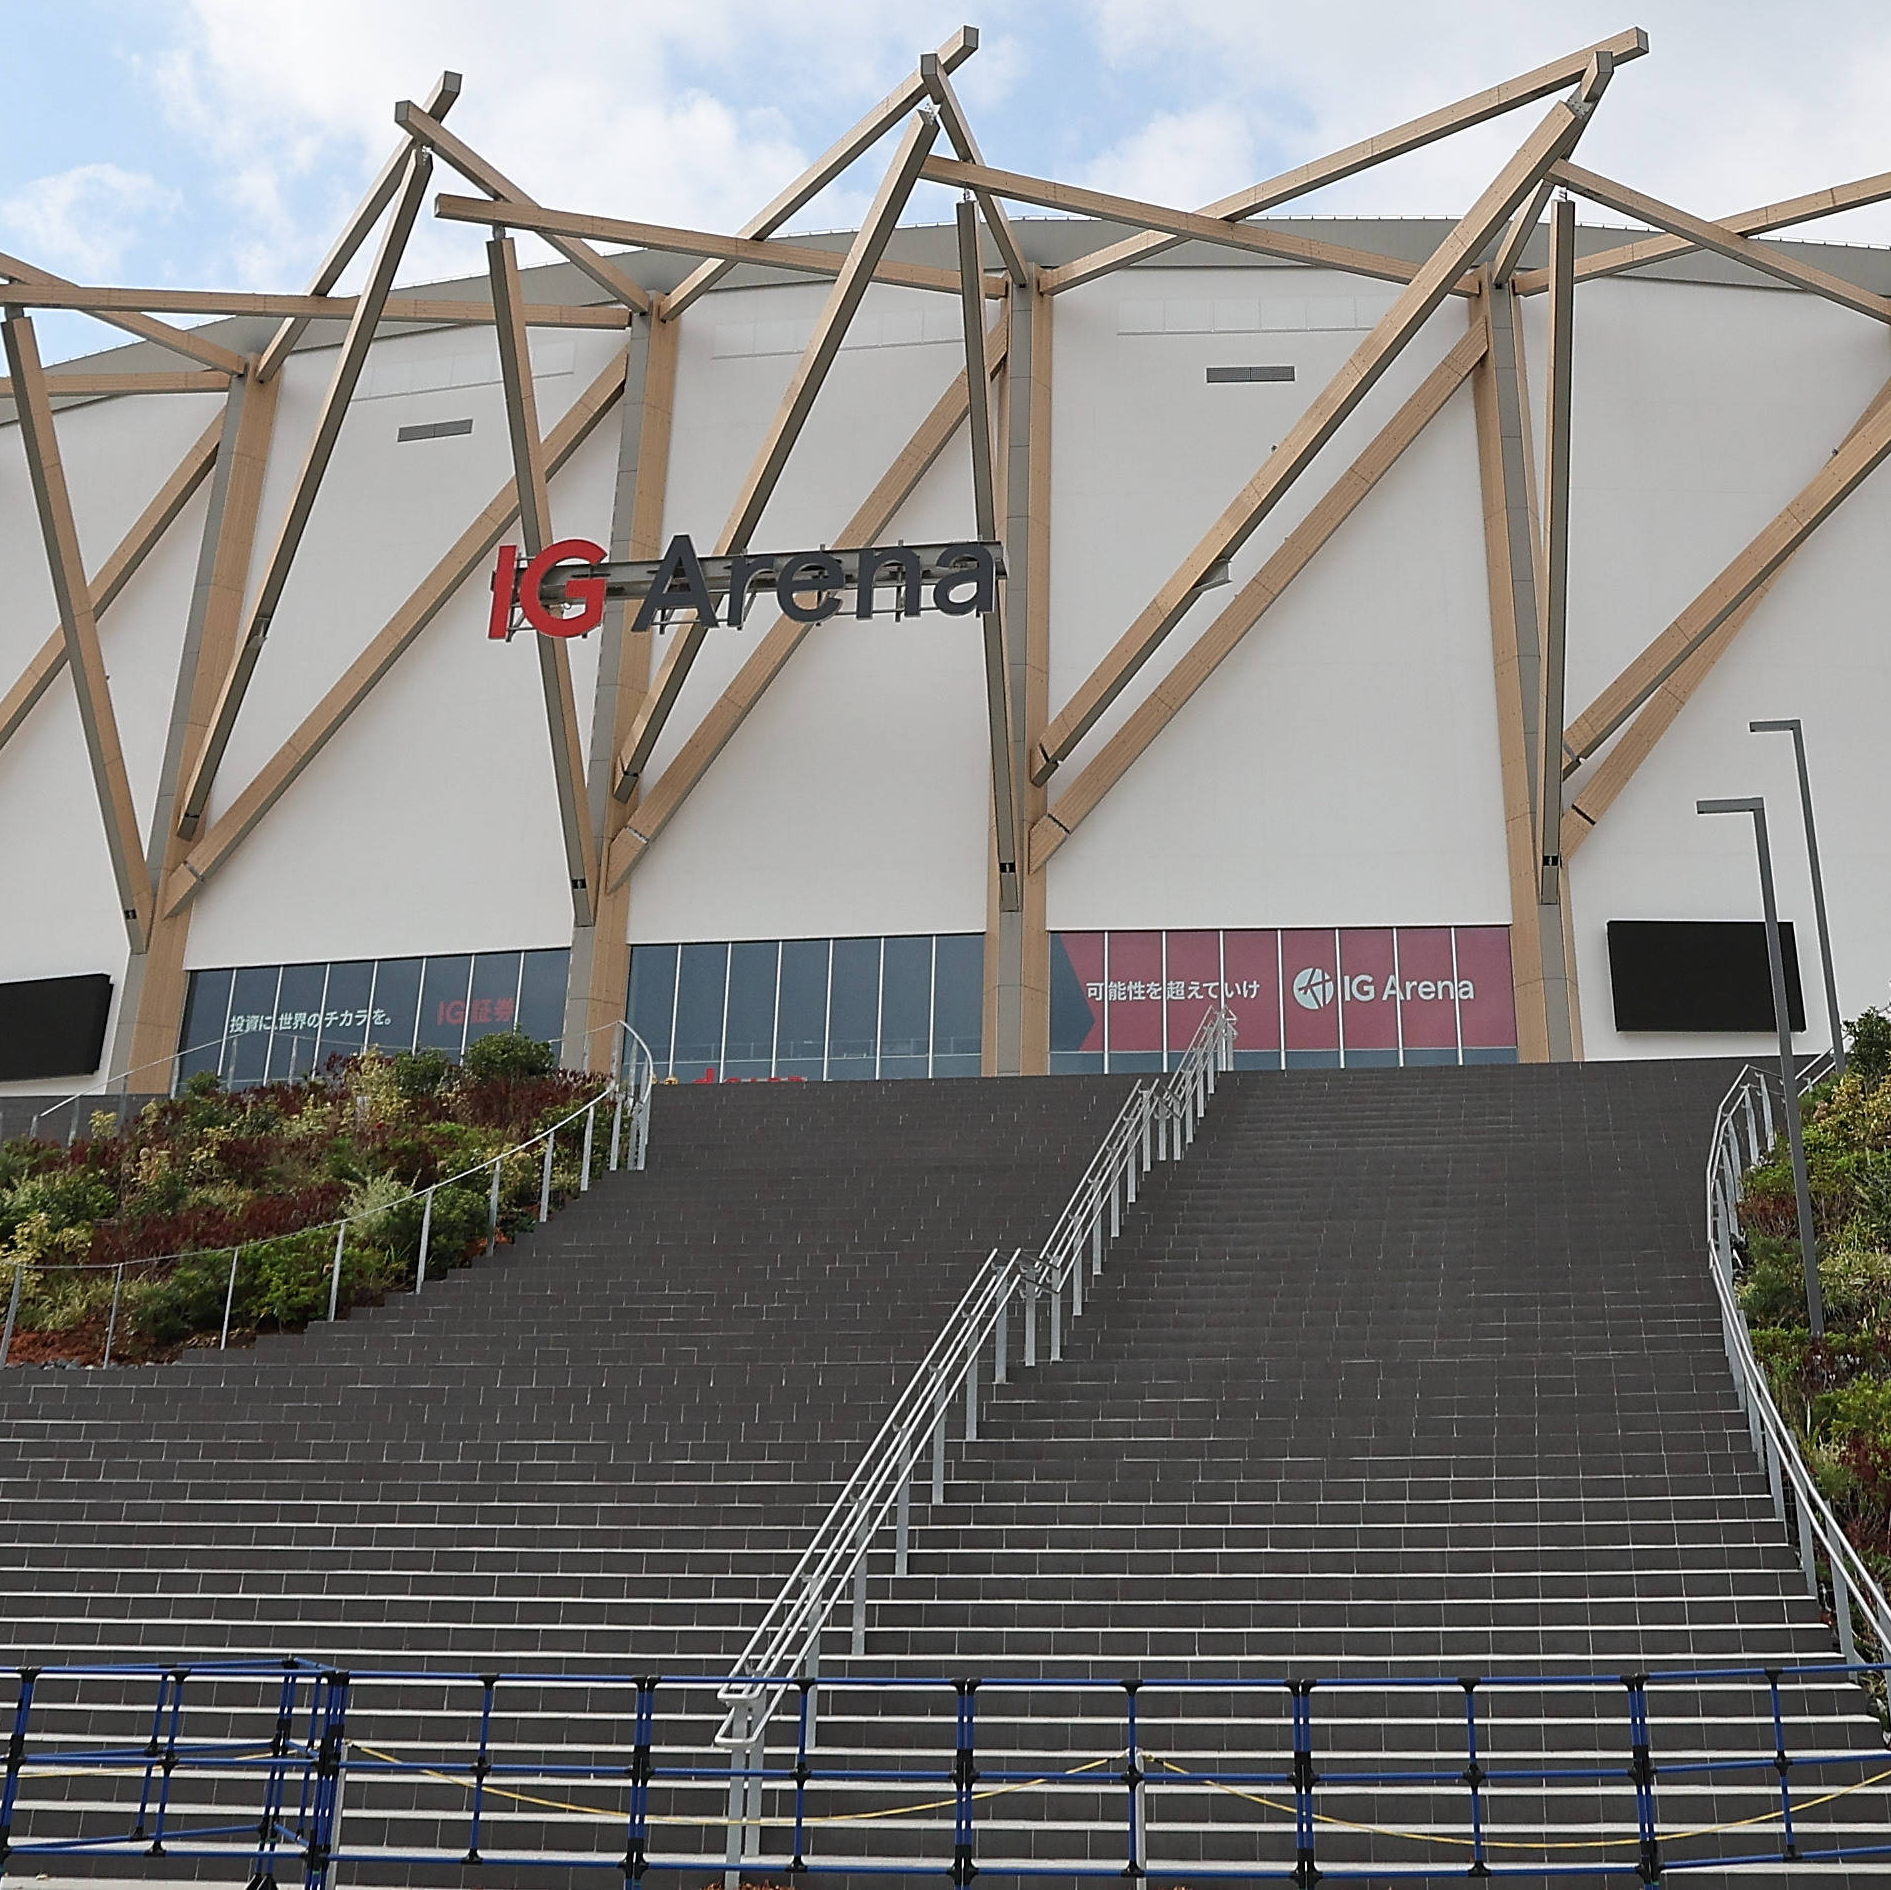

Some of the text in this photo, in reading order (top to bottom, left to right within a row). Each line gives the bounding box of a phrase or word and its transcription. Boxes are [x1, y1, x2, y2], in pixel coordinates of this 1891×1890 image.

[488, 534, 996, 640] IG Arena
[1086, 980, 1260, 1002] 可能性を超えていけ
[1343, 974, 1475, 1002] IG Arena
